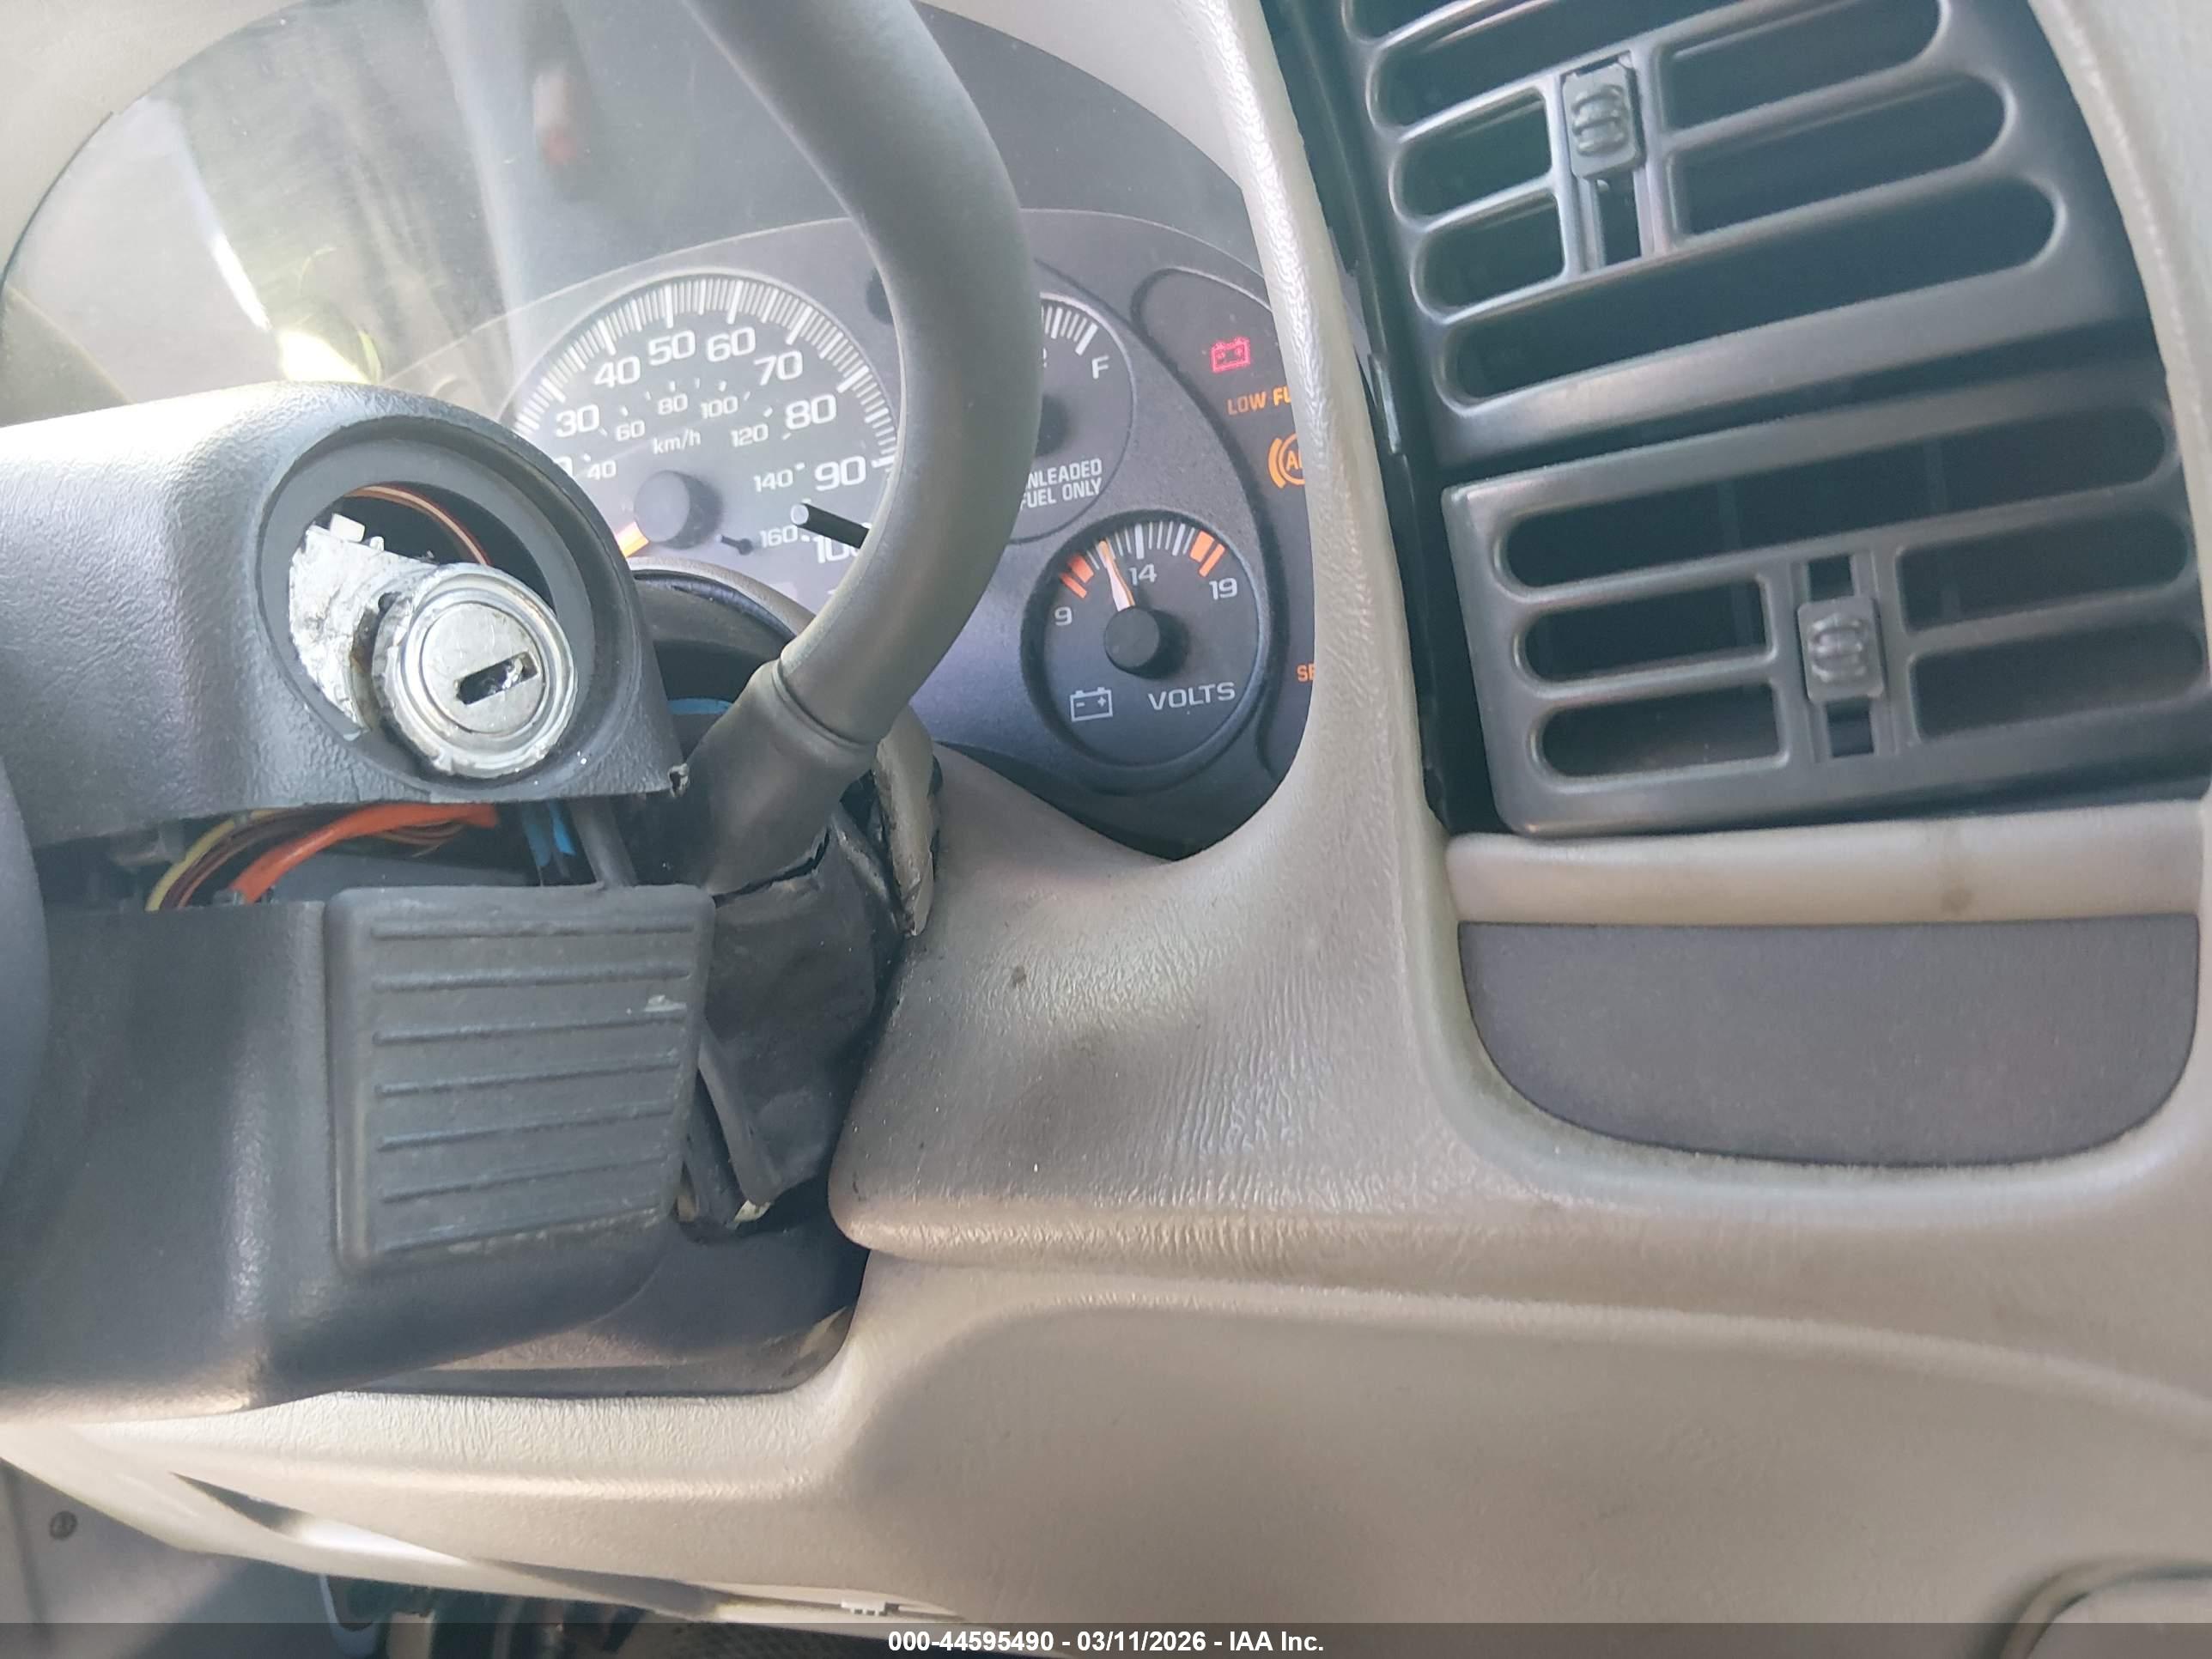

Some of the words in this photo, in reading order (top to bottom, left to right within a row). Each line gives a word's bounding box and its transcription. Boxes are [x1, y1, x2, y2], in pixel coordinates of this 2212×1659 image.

[648, 330, 696, 366] 50
[706, 327, 756, 362] 60
[594, 356, 641, 388] 40
[754, 351, 804, 386] 70
[1091, 355, 1109, 380] F
[657, 393, 688, 416] 80
[700, 396, 738, 419] 100
[785, 394, 836, 430] 80
[1226, 391, 1267, 416] LOW
[1273, 385, 1291, 406] FU
[556, 404, 599, 438] 30
[616, 420, 645, 441] 60
[653, 432, 701, 455] km/h
[731, 424, 769, 447] 120
[587, 460, 617, 480] 40
[754, 469, 793, 493] 140
[815, 456, 866, 490] 90
[1026, 458, 1103, 489] NLEADED
[1062, 477, 1103, 501] ONLY
[759, 525, 799, 548] 160
[811, 534, 860, 563] 10
[1129, 563, 1157, 586] 14
[1209, 577, 1237, 600] 19
[1054, 607, 1073, 626] 9
[1148, 682, 1236, 710] VOLTS
